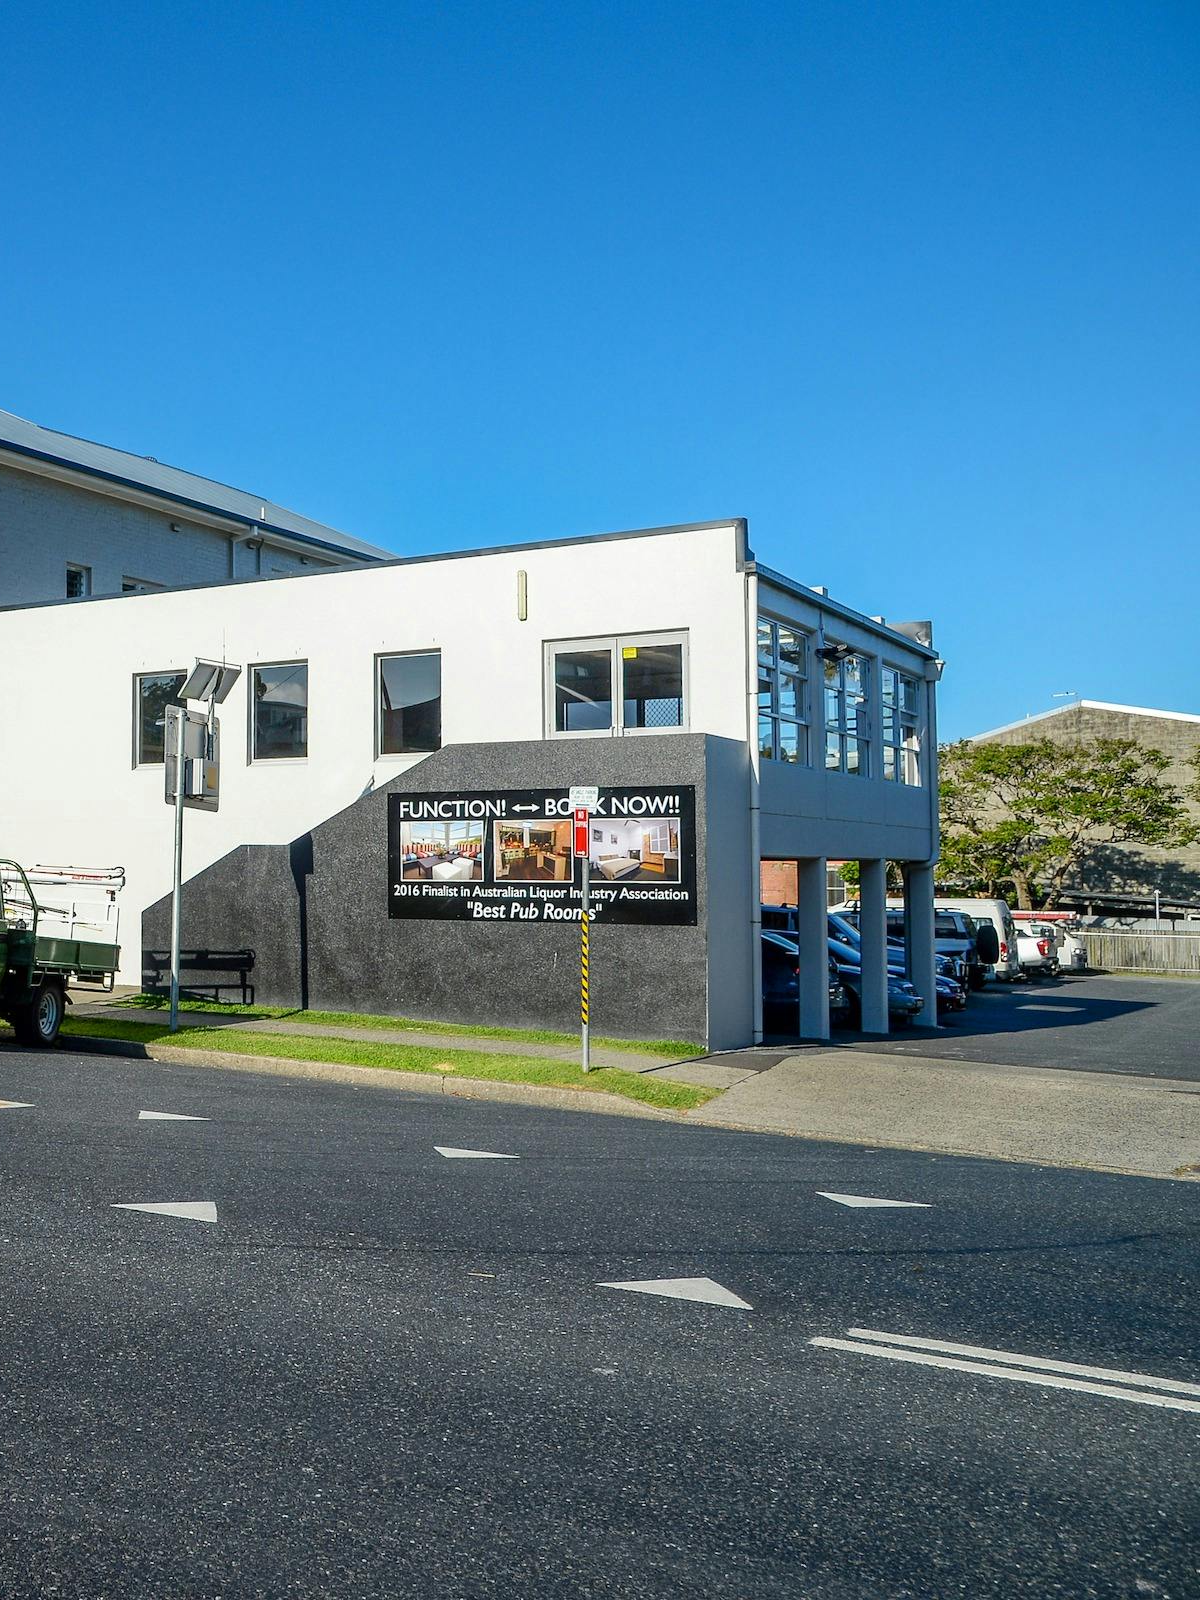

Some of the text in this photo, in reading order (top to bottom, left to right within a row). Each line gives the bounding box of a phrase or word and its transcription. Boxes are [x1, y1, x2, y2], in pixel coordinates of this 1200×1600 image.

[399, 799, 507, 818] FUNCTION!
[544, 797, 607, 816] BOK
[611, 795, 680, 815] NOW!!
[393, 885, 420, 897] 2016
[422, 885, 458, 897] Finalist
[460, 886, 470, 897] in
[472, 886, 527, 898] Australian
[530, 886, 567, 901] Liquor
[619, 887, 689, 900] Association
[467, 901, 506, 918] "Best
[510, 902, 539, 919] Pub
